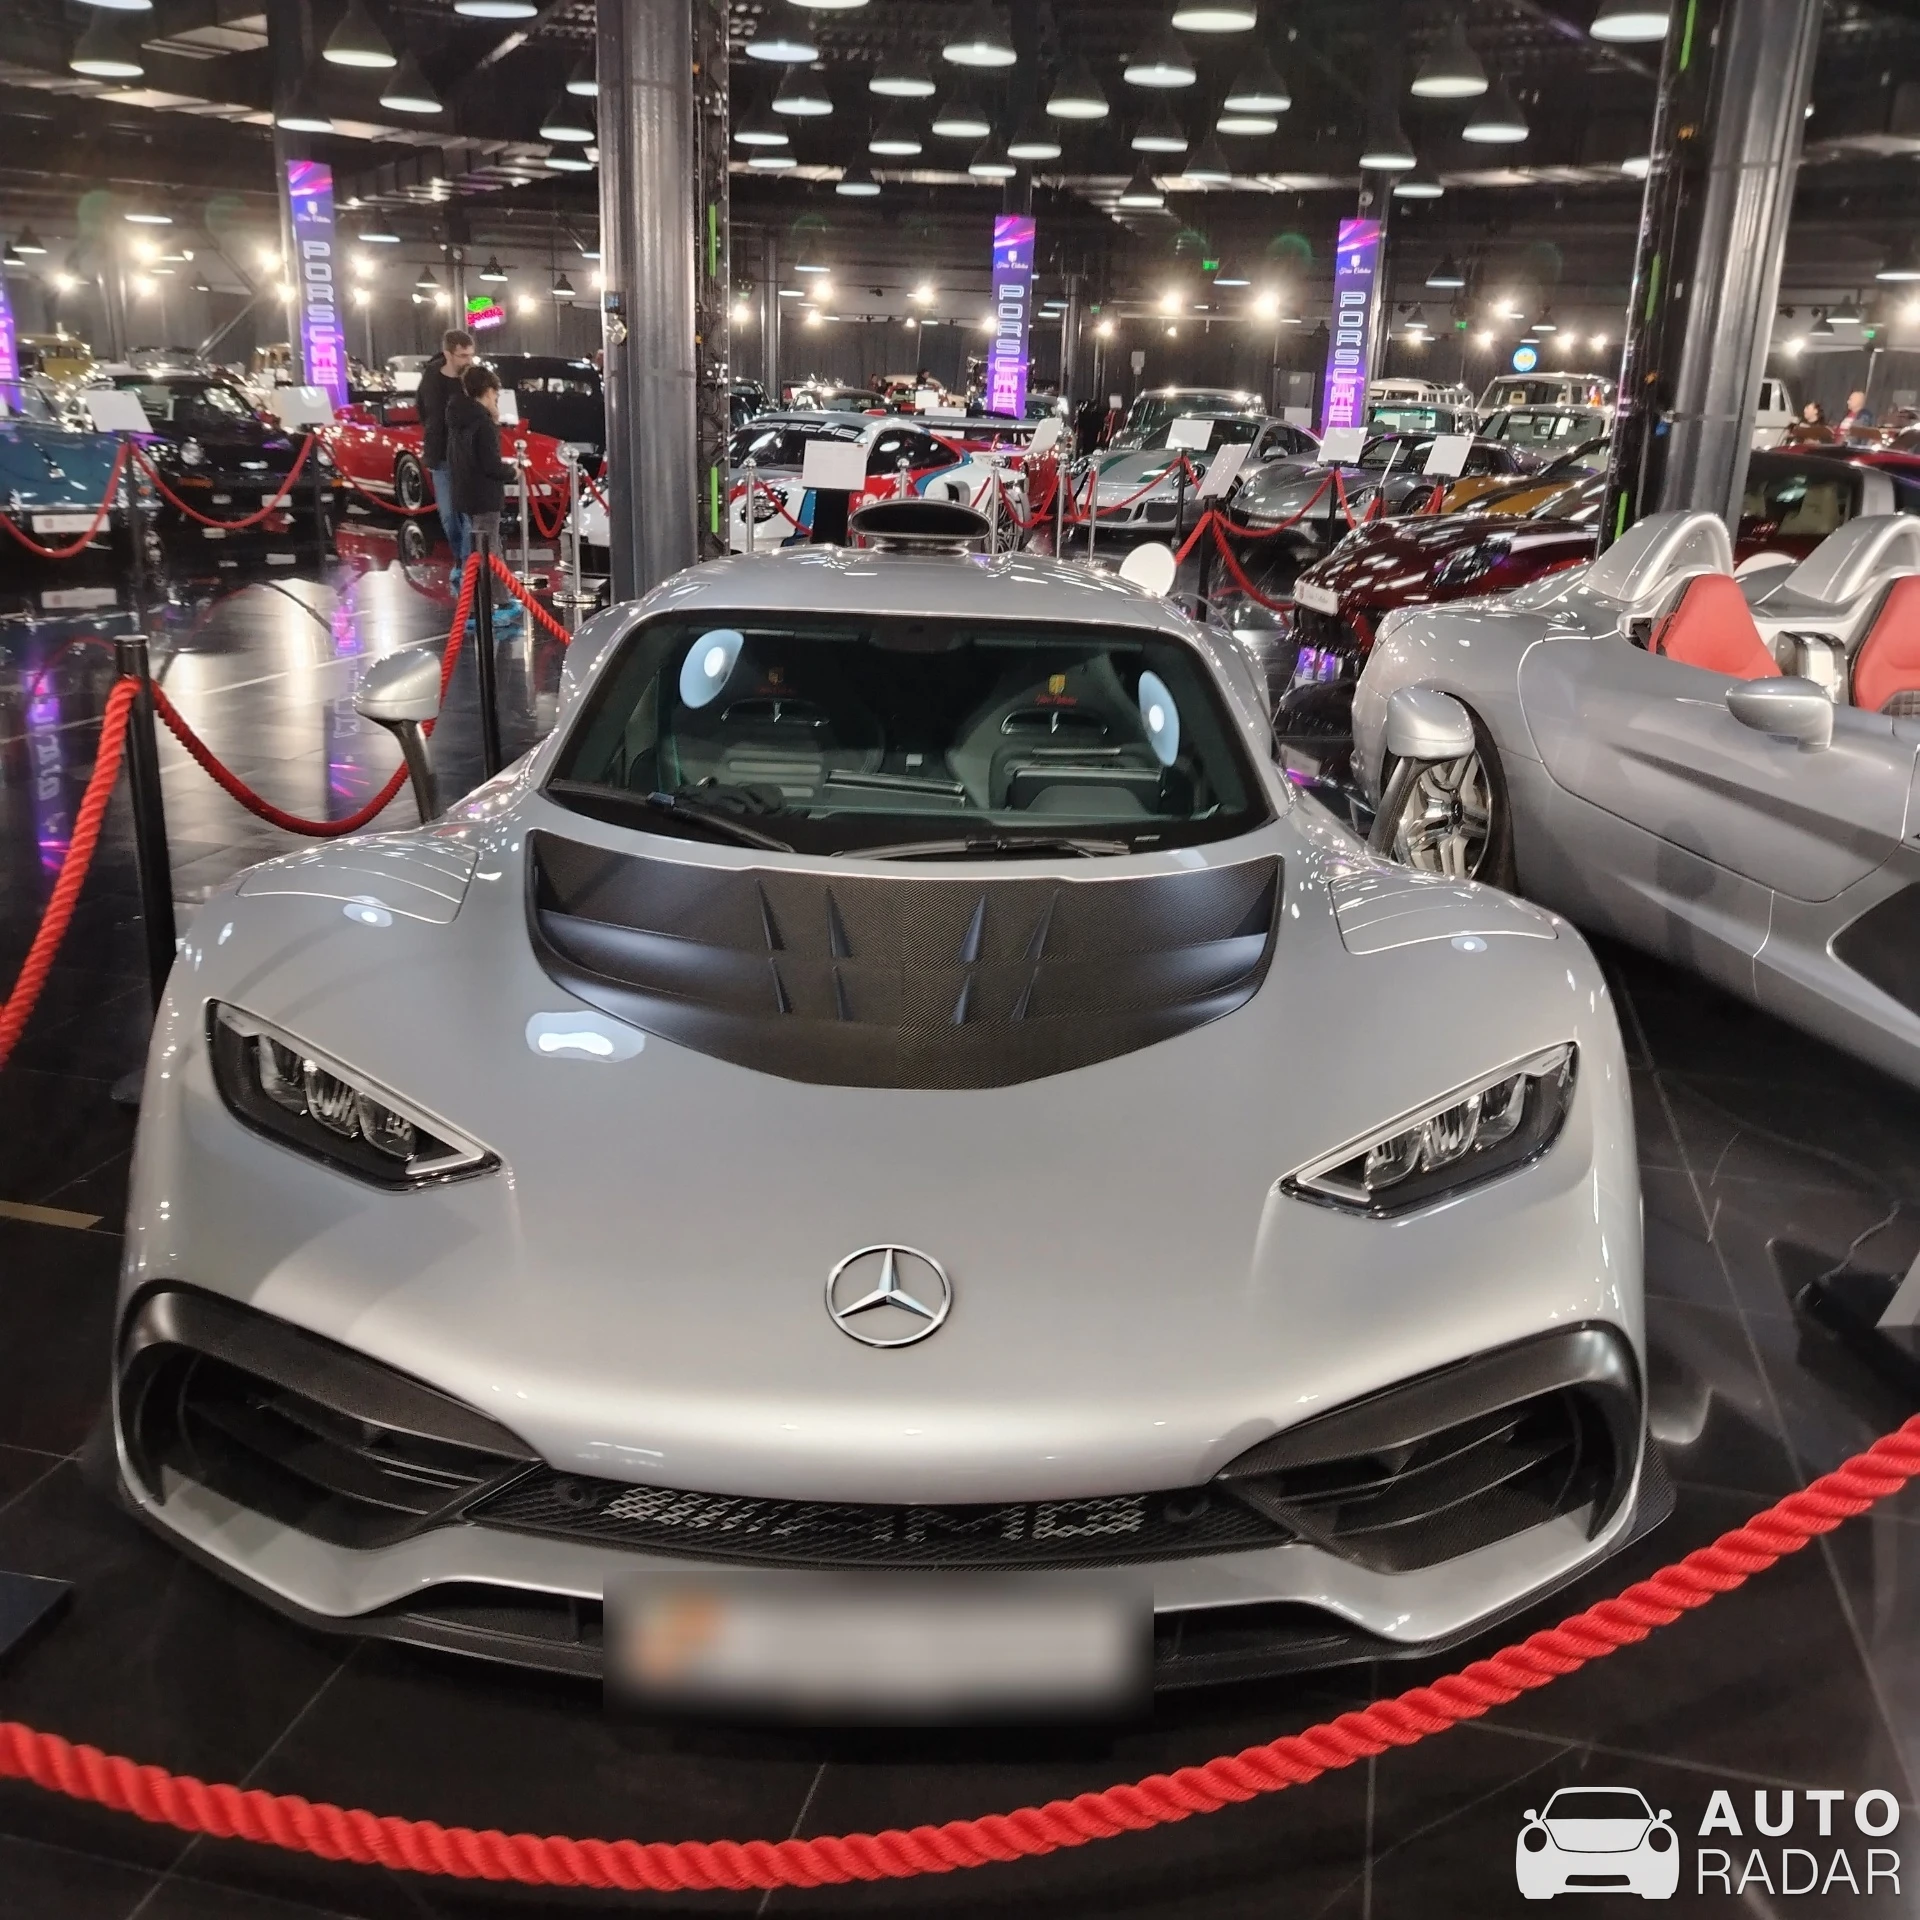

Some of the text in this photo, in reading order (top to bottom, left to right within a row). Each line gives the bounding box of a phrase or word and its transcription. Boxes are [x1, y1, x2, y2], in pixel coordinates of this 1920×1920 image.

[302, 240, 339, 385] PORSCHE
[993, 284, 1025, 408] PORSCHE
[1328, 291, 1366, 422] PORSCHE
[740, 422, 860, 440] PORSCHE
